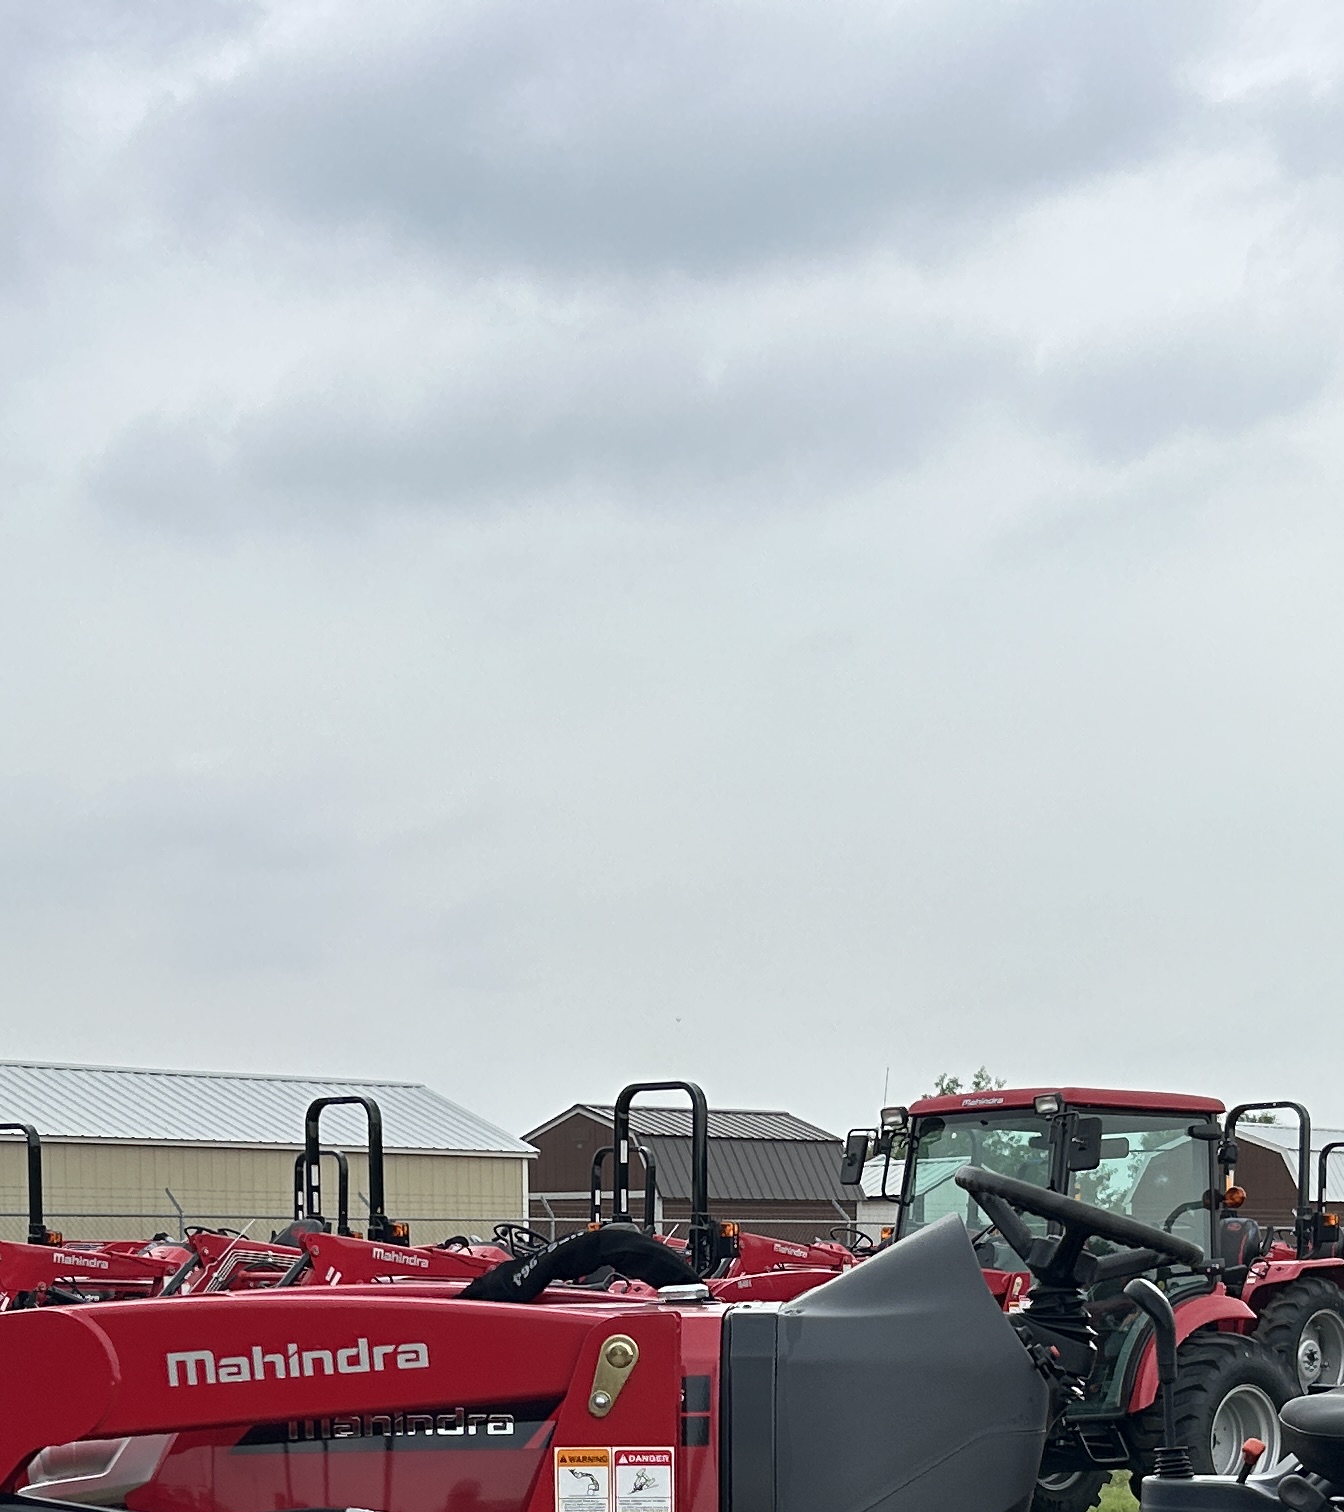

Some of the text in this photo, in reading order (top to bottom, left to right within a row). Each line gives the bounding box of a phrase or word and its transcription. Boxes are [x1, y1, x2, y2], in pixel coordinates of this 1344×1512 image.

[52, 1253, 109, 1270] Mahindra
[372, 1248, 429, 1268] Mahindra
[166, 1337, 430, 1387] Mahindra
[628, 1455, 669, 1463] DANGER
